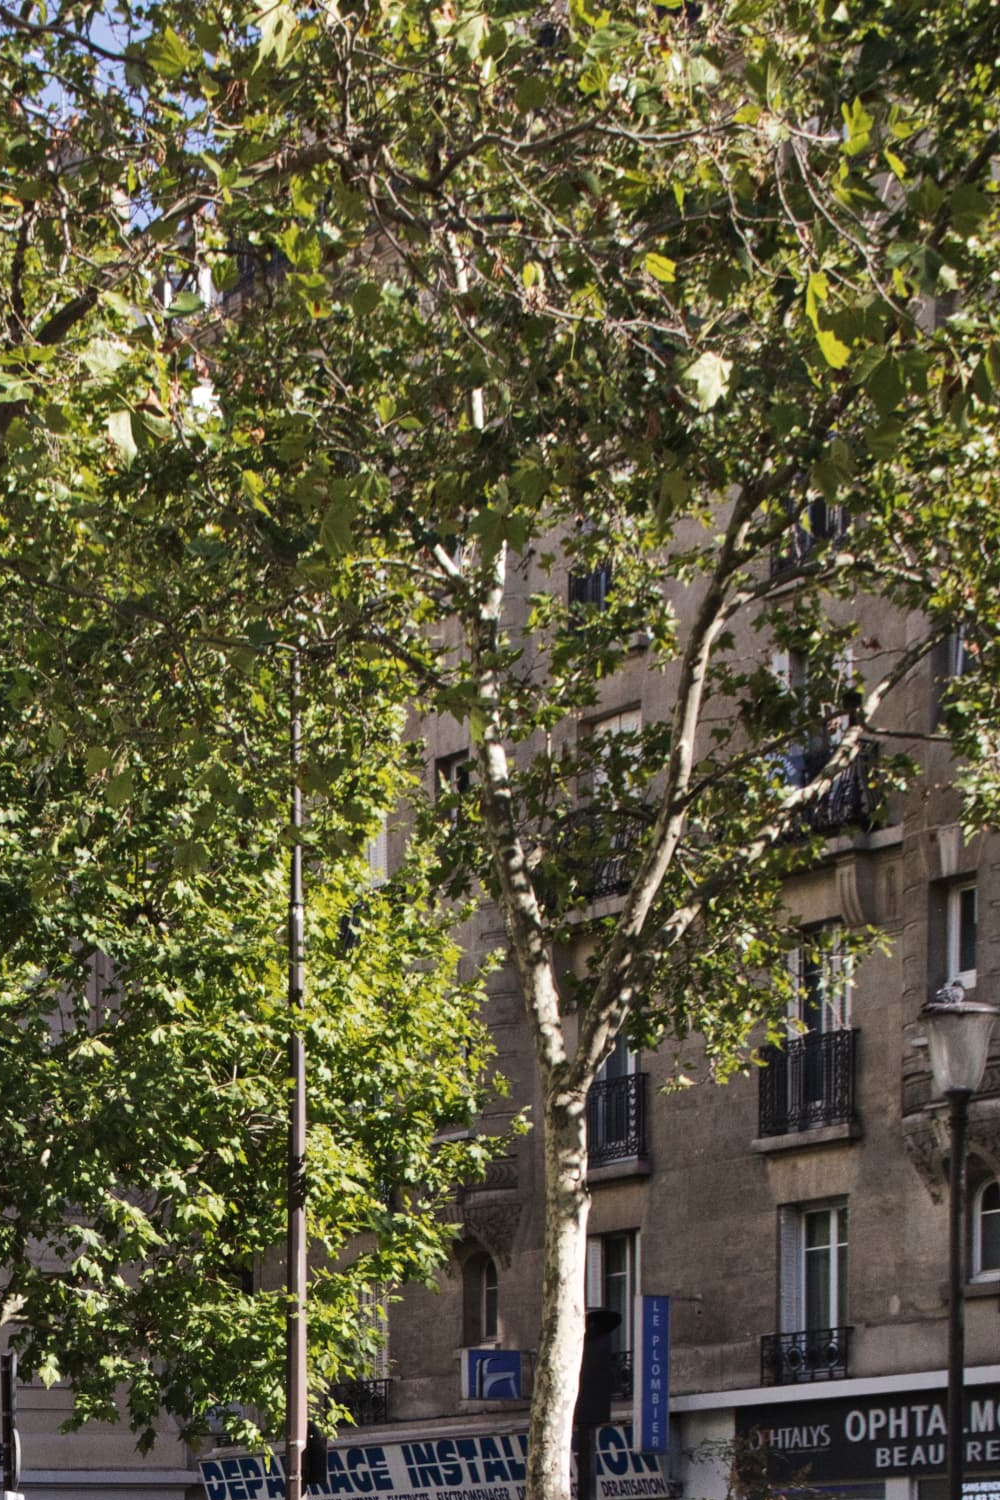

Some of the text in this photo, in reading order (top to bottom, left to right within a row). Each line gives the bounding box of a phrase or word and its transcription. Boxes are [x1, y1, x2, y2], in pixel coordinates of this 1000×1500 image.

[650, 1300, 661, 1448] LE PLOMBIER
[845, 1400, 1000, 1442] OPHTAM
[875, 1440, 1000, 1468] BEAURE
[601, 1477, 668, 1497] DERATISATION
